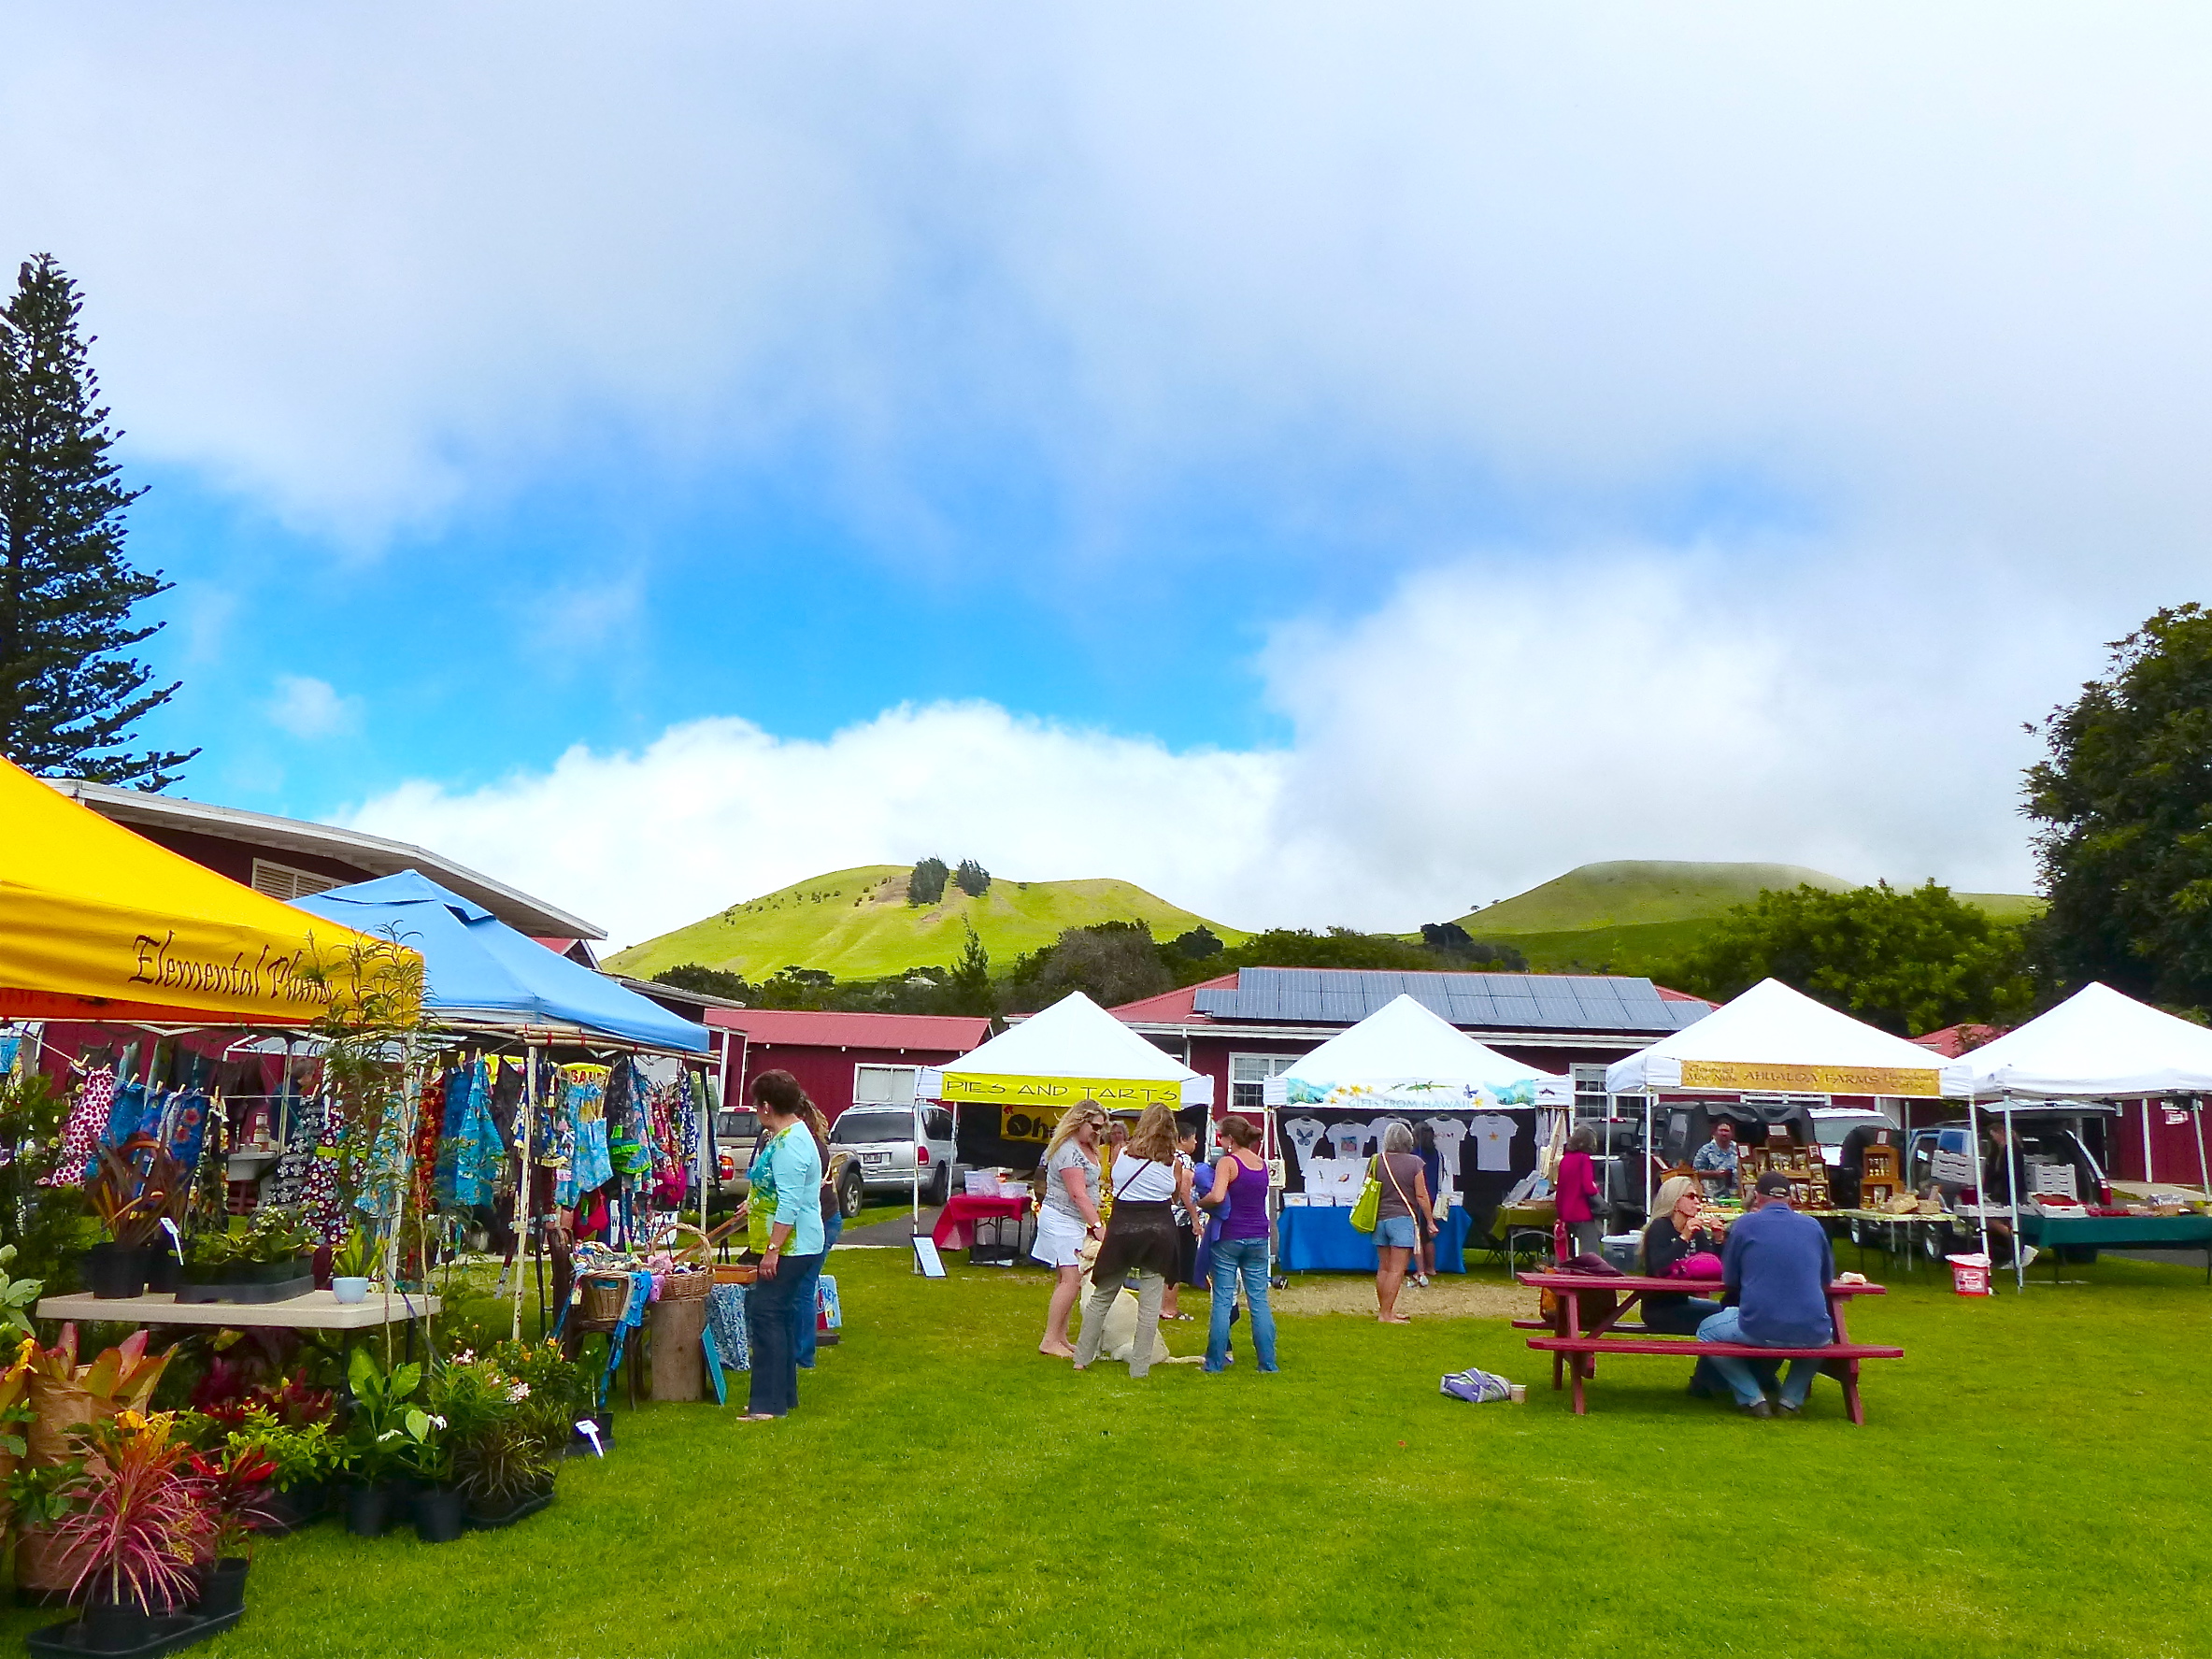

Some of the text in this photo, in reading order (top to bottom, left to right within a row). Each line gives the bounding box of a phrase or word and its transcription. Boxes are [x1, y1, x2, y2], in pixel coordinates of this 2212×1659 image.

[128, 930, 270, 997] Elemental
[1743, 1071, 1878, 1084] AHUALOA FARMS
[947, 1080, 1178, 1102] PIES AND TARTS
[1348, 1098, 1470, 1108] GIFTS FROM HAWAII
